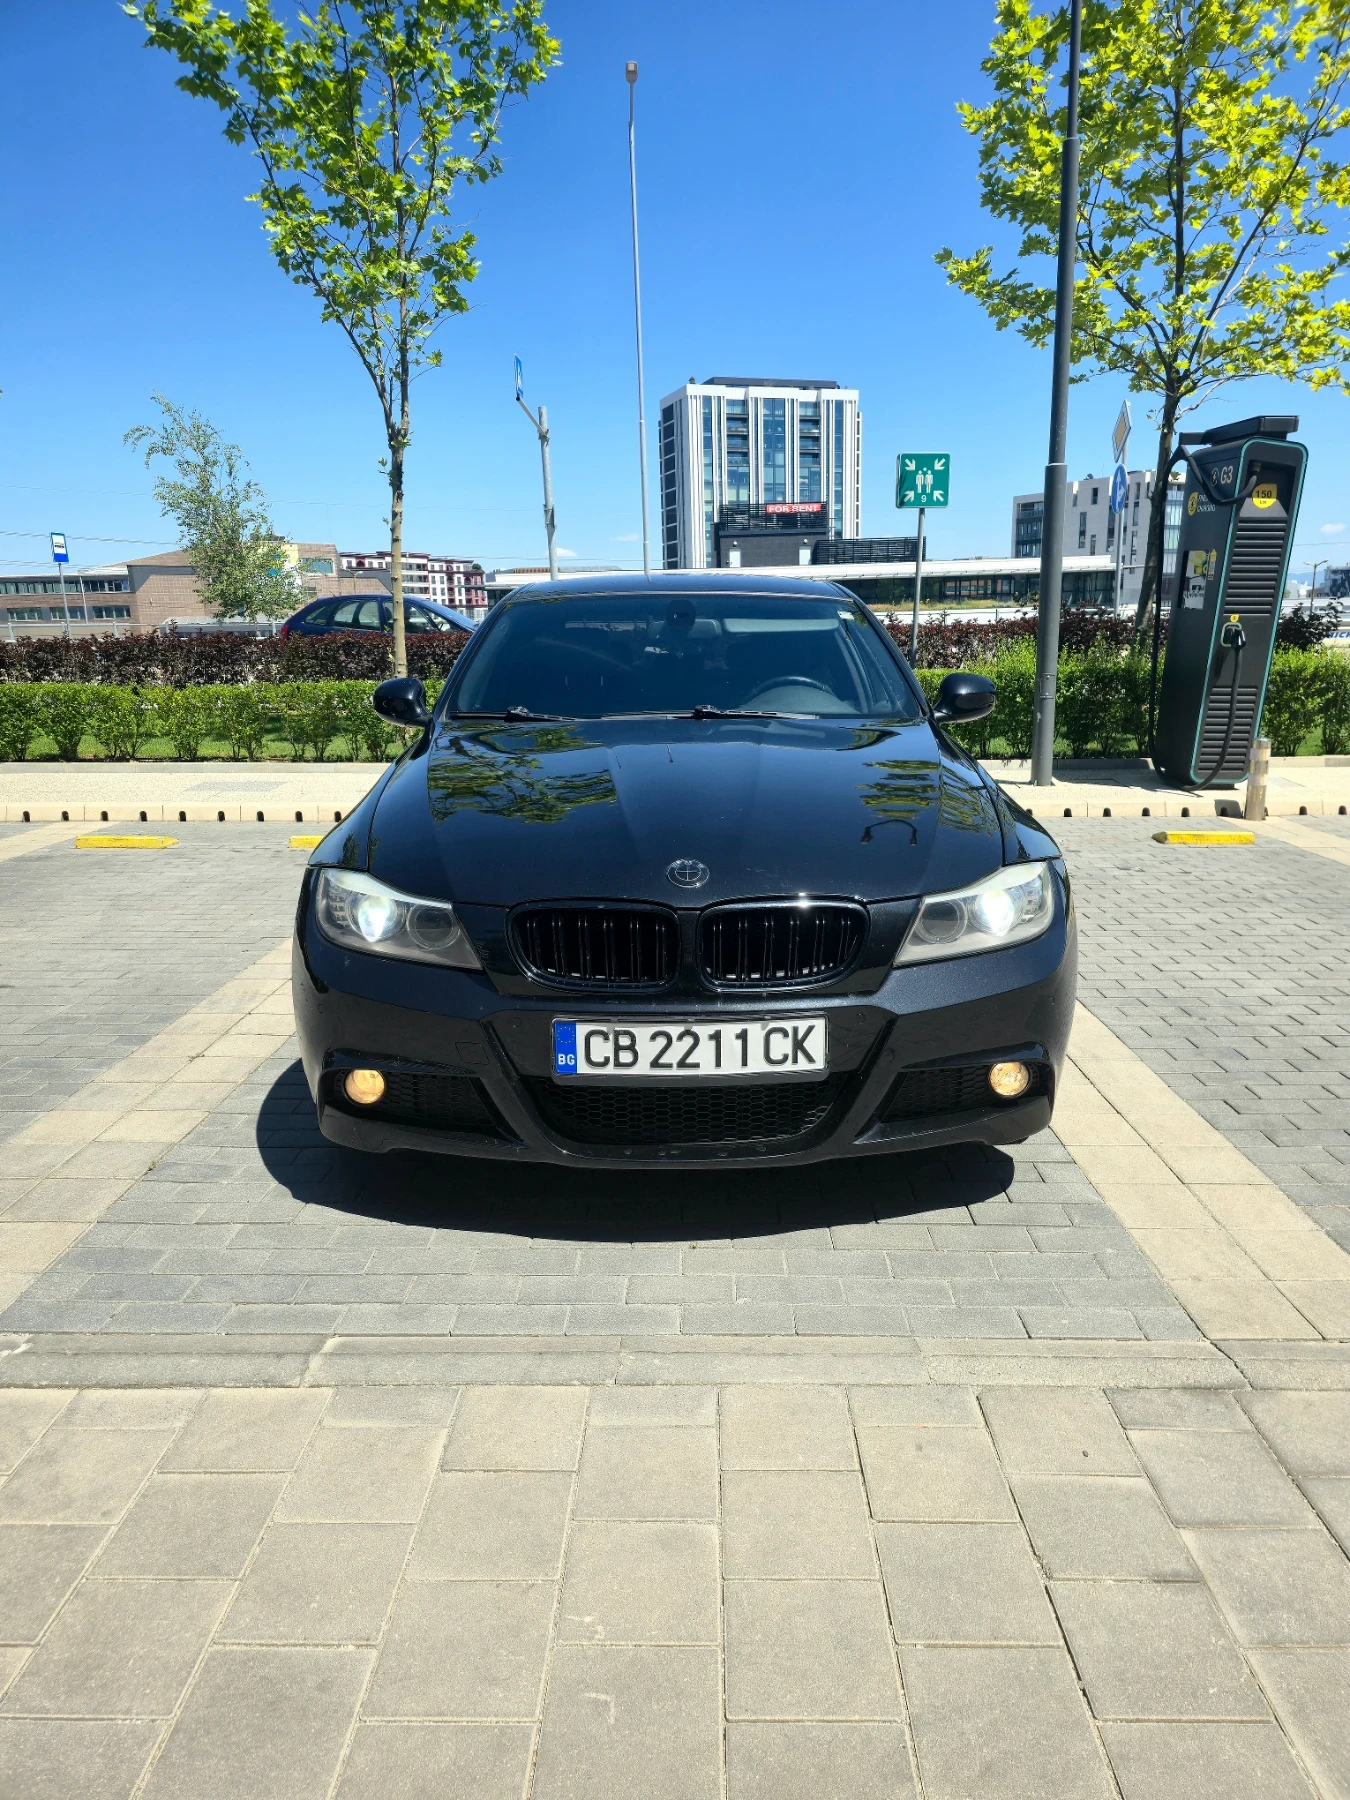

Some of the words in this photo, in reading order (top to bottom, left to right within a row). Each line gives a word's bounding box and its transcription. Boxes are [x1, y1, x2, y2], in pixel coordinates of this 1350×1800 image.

[1220, 465, 1234, 484] G3
[921, 494, 927, 503] 9
[1255, 490, 1273, 499] 150
[769, 505, 790, 513] FOR
[584, 1029, 639, 1069] CB
[649, 1028, 748, 1068] 2211
[763, 1025, 816, 1065] CK
[557, 1053, 575, 1066] BG
